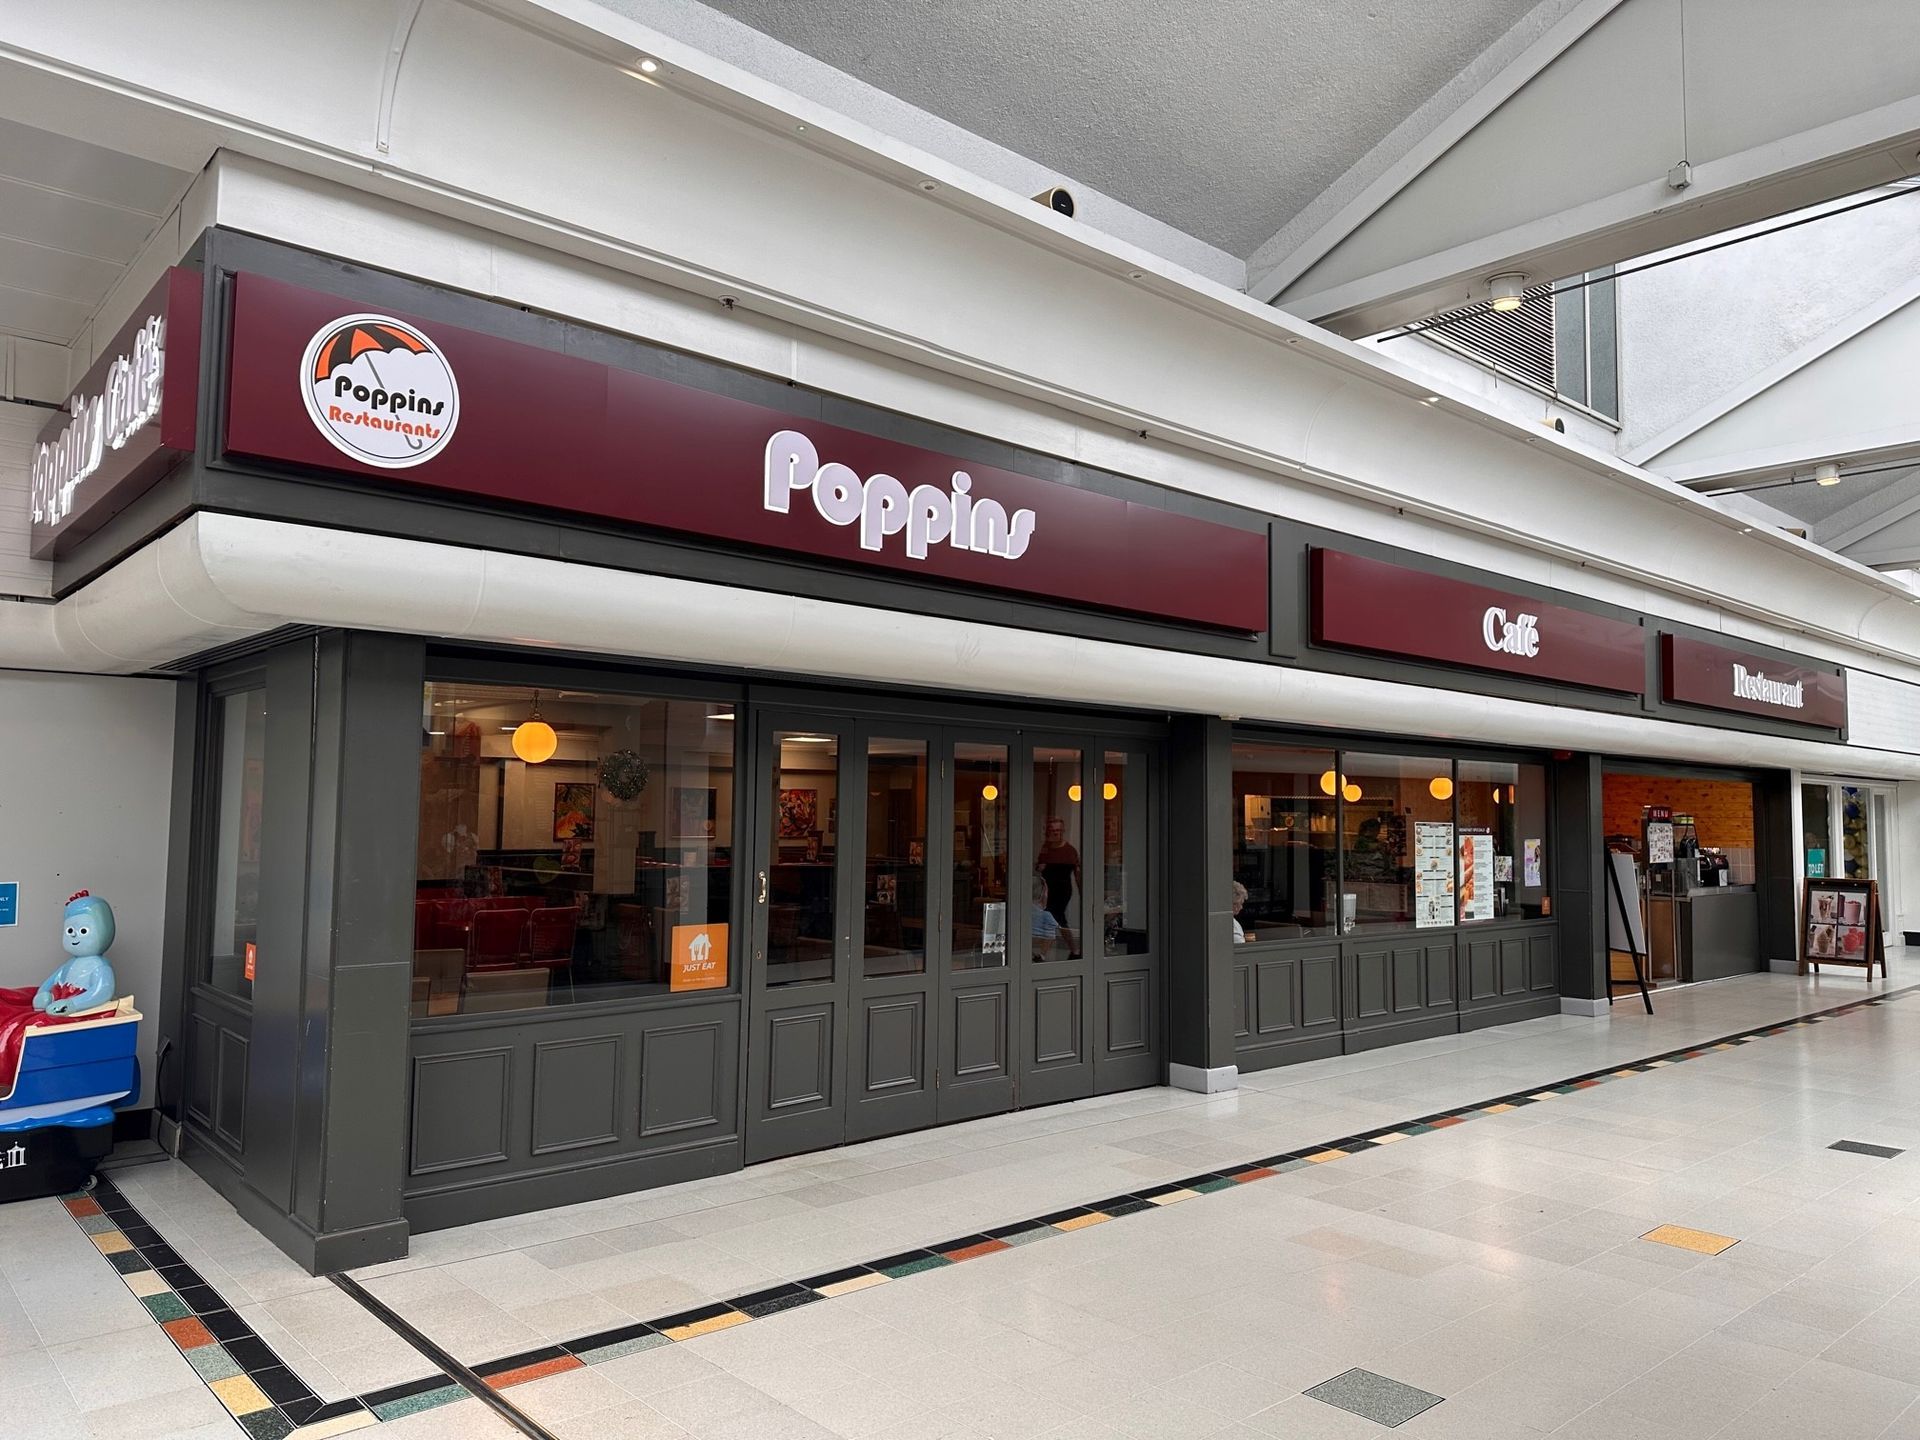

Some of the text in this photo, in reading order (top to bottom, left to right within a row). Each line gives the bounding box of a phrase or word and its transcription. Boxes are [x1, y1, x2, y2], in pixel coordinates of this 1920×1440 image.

[335, 375, 444, 416] Poppins
[328, 405, 440, 439] Restaurants
[764, 430, 1036, 560] Poppins
[1483, 606, 1540, 658] Café
[1733, 663, 1804, 708] Restaurant
[1653, 809, 1669, 818] MENU
[682, 961, 716, 973] JUST EAT
